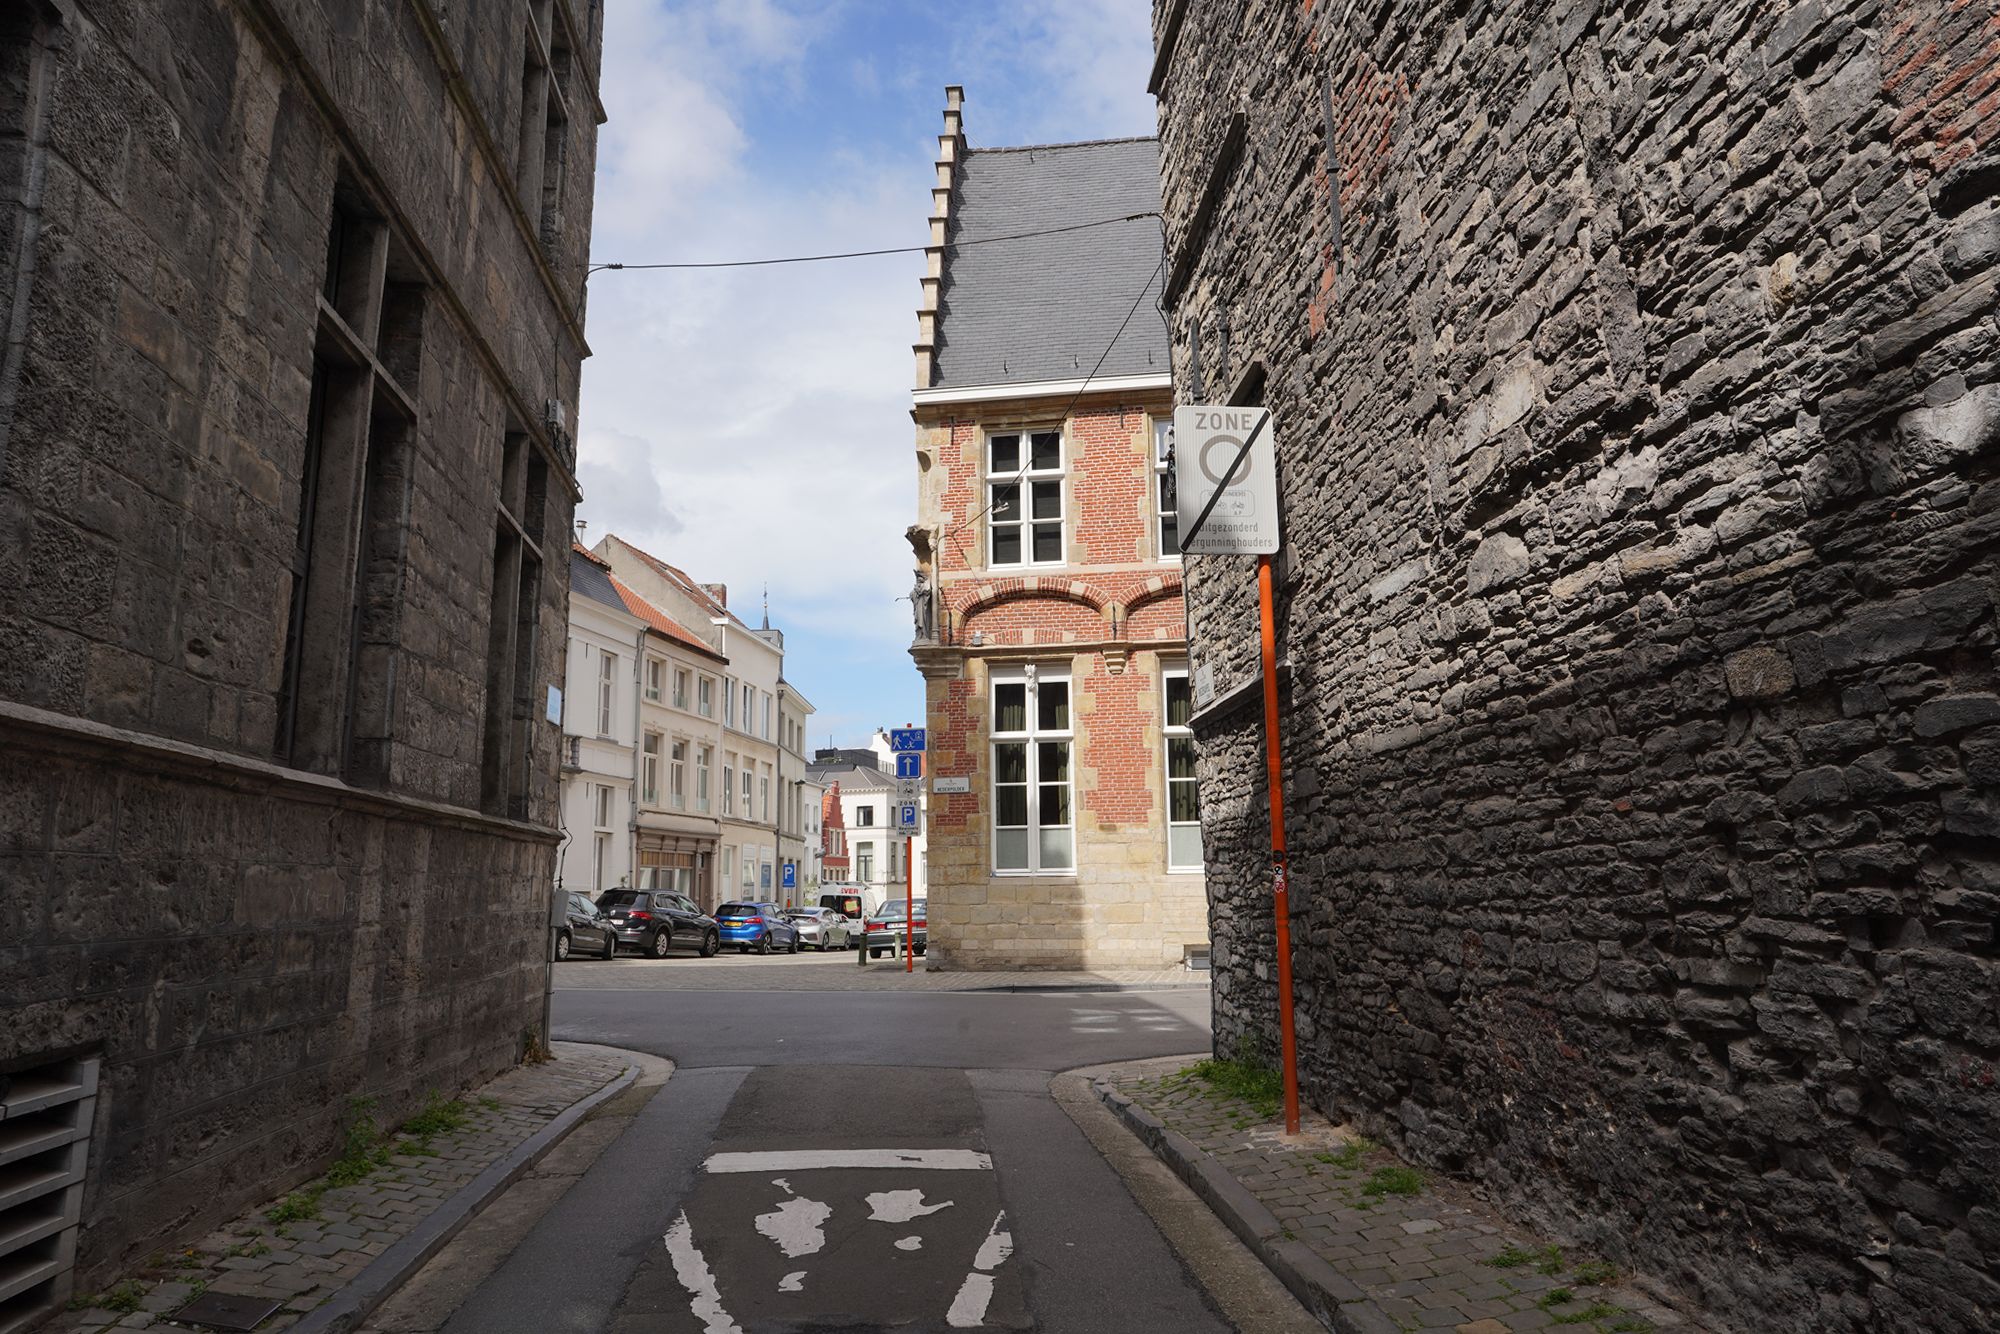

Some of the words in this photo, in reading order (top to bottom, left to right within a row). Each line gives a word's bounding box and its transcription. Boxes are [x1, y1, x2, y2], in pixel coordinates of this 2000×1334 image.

[1195, 412, 1253, 431] ZONE
[1190, 537, 1273, 550] ergunninghouders
[785, 867, 793, 879] P
